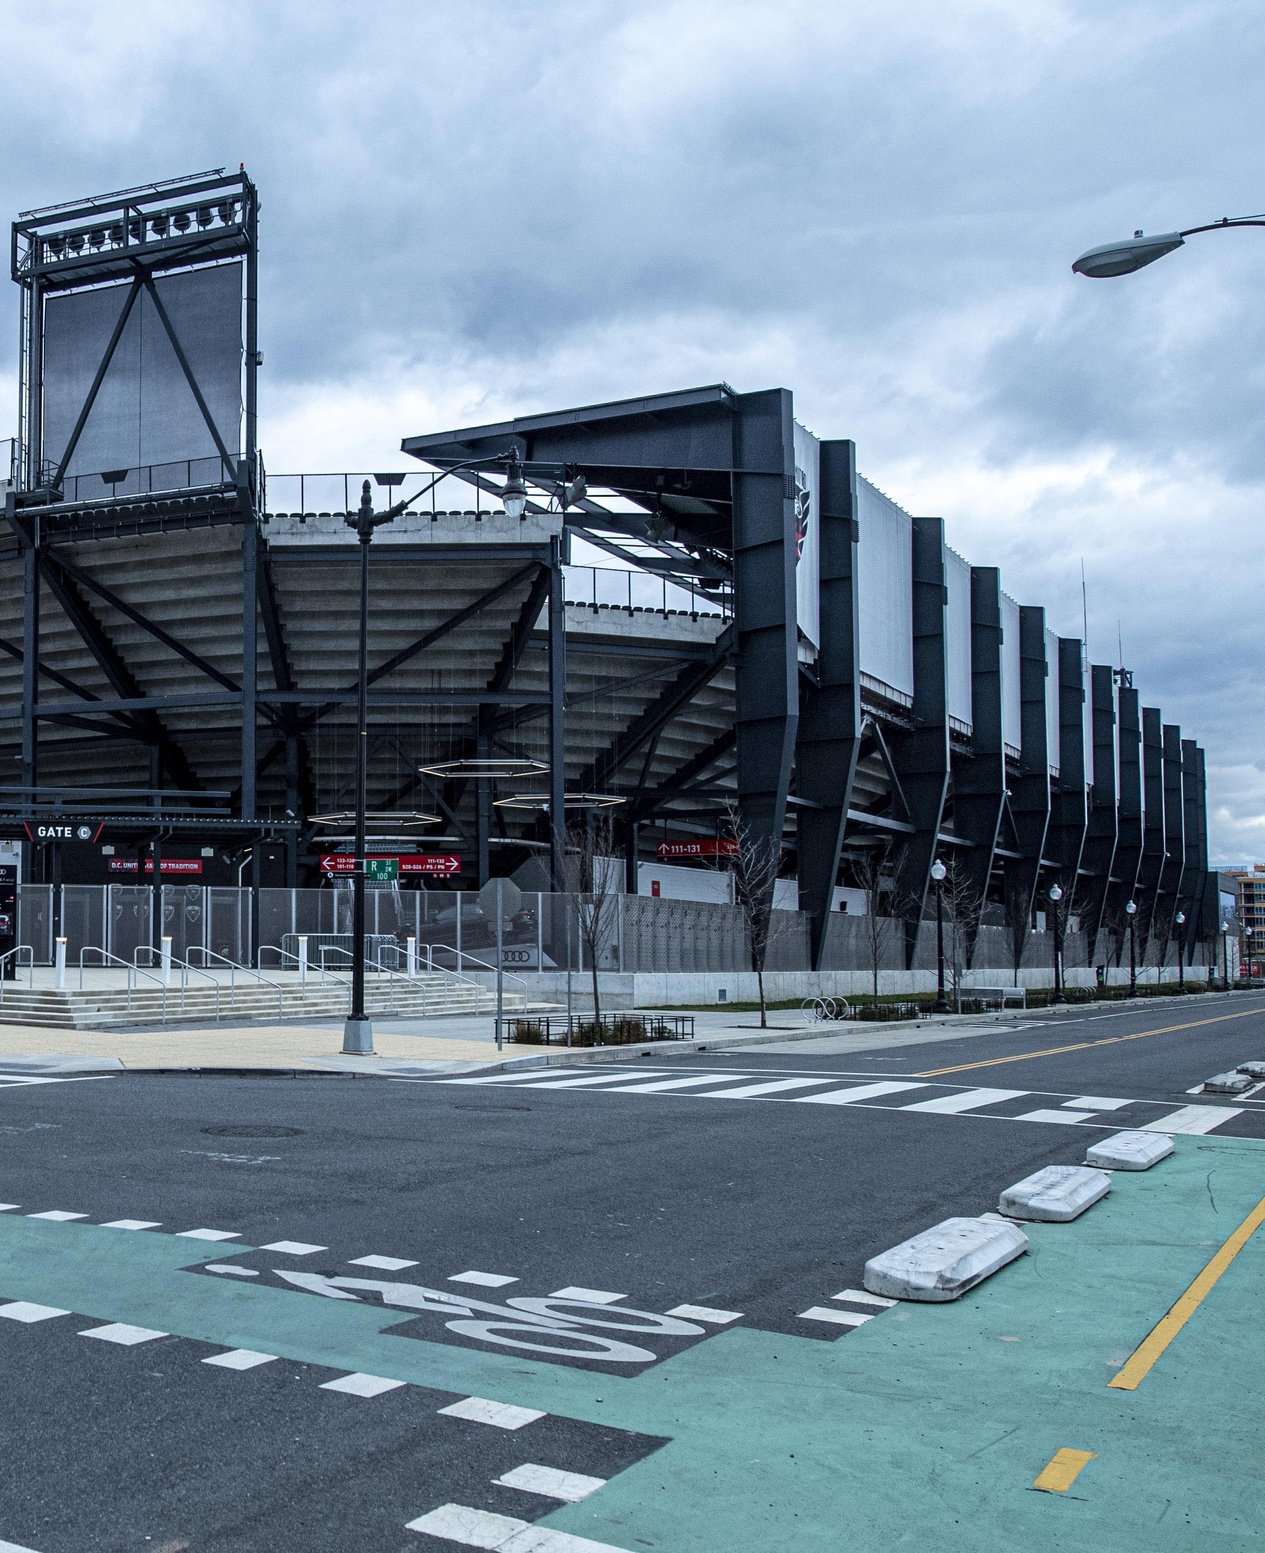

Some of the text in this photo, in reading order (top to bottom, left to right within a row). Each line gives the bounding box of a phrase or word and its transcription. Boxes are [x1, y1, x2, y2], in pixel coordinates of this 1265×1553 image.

[37, 826, 88, 838] GATE C
[670, 844, 701, 853] 111-131
[371, 860, 377, 872] R
[376, 872, 388, 880] 100
